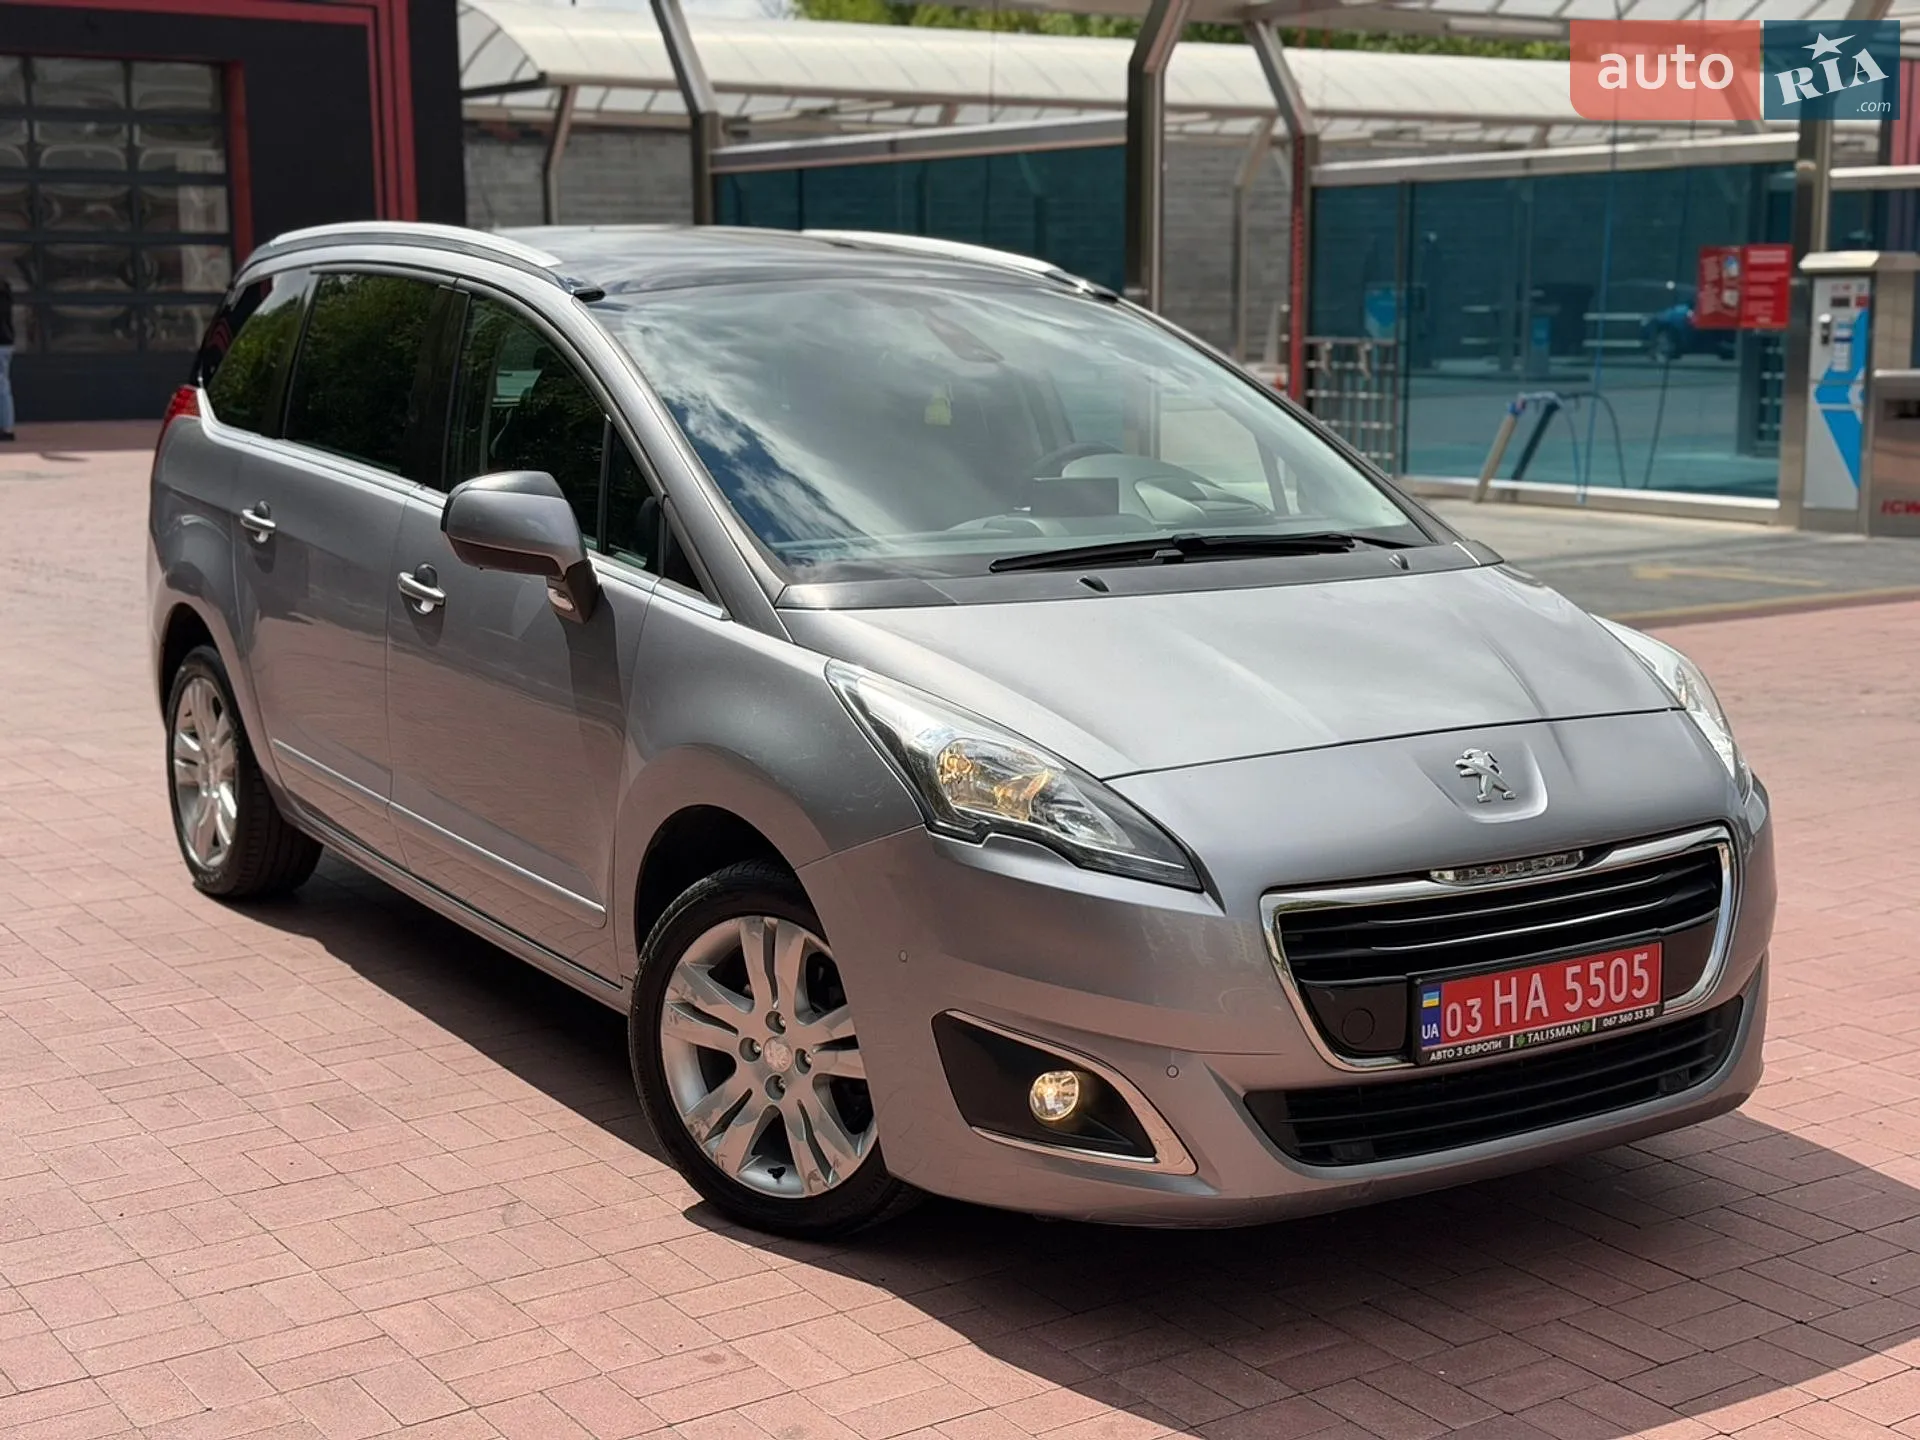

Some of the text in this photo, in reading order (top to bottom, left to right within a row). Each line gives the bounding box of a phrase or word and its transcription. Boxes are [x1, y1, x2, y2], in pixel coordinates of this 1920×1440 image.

[1445, 952, 1650, 1038] 03 HA 5505
[1421, 1023, 1439, 1040] UA
[1527, 1024, 1581, 1043] TALISMAN
[1430, 1048, 1455, 1061] АВТО
